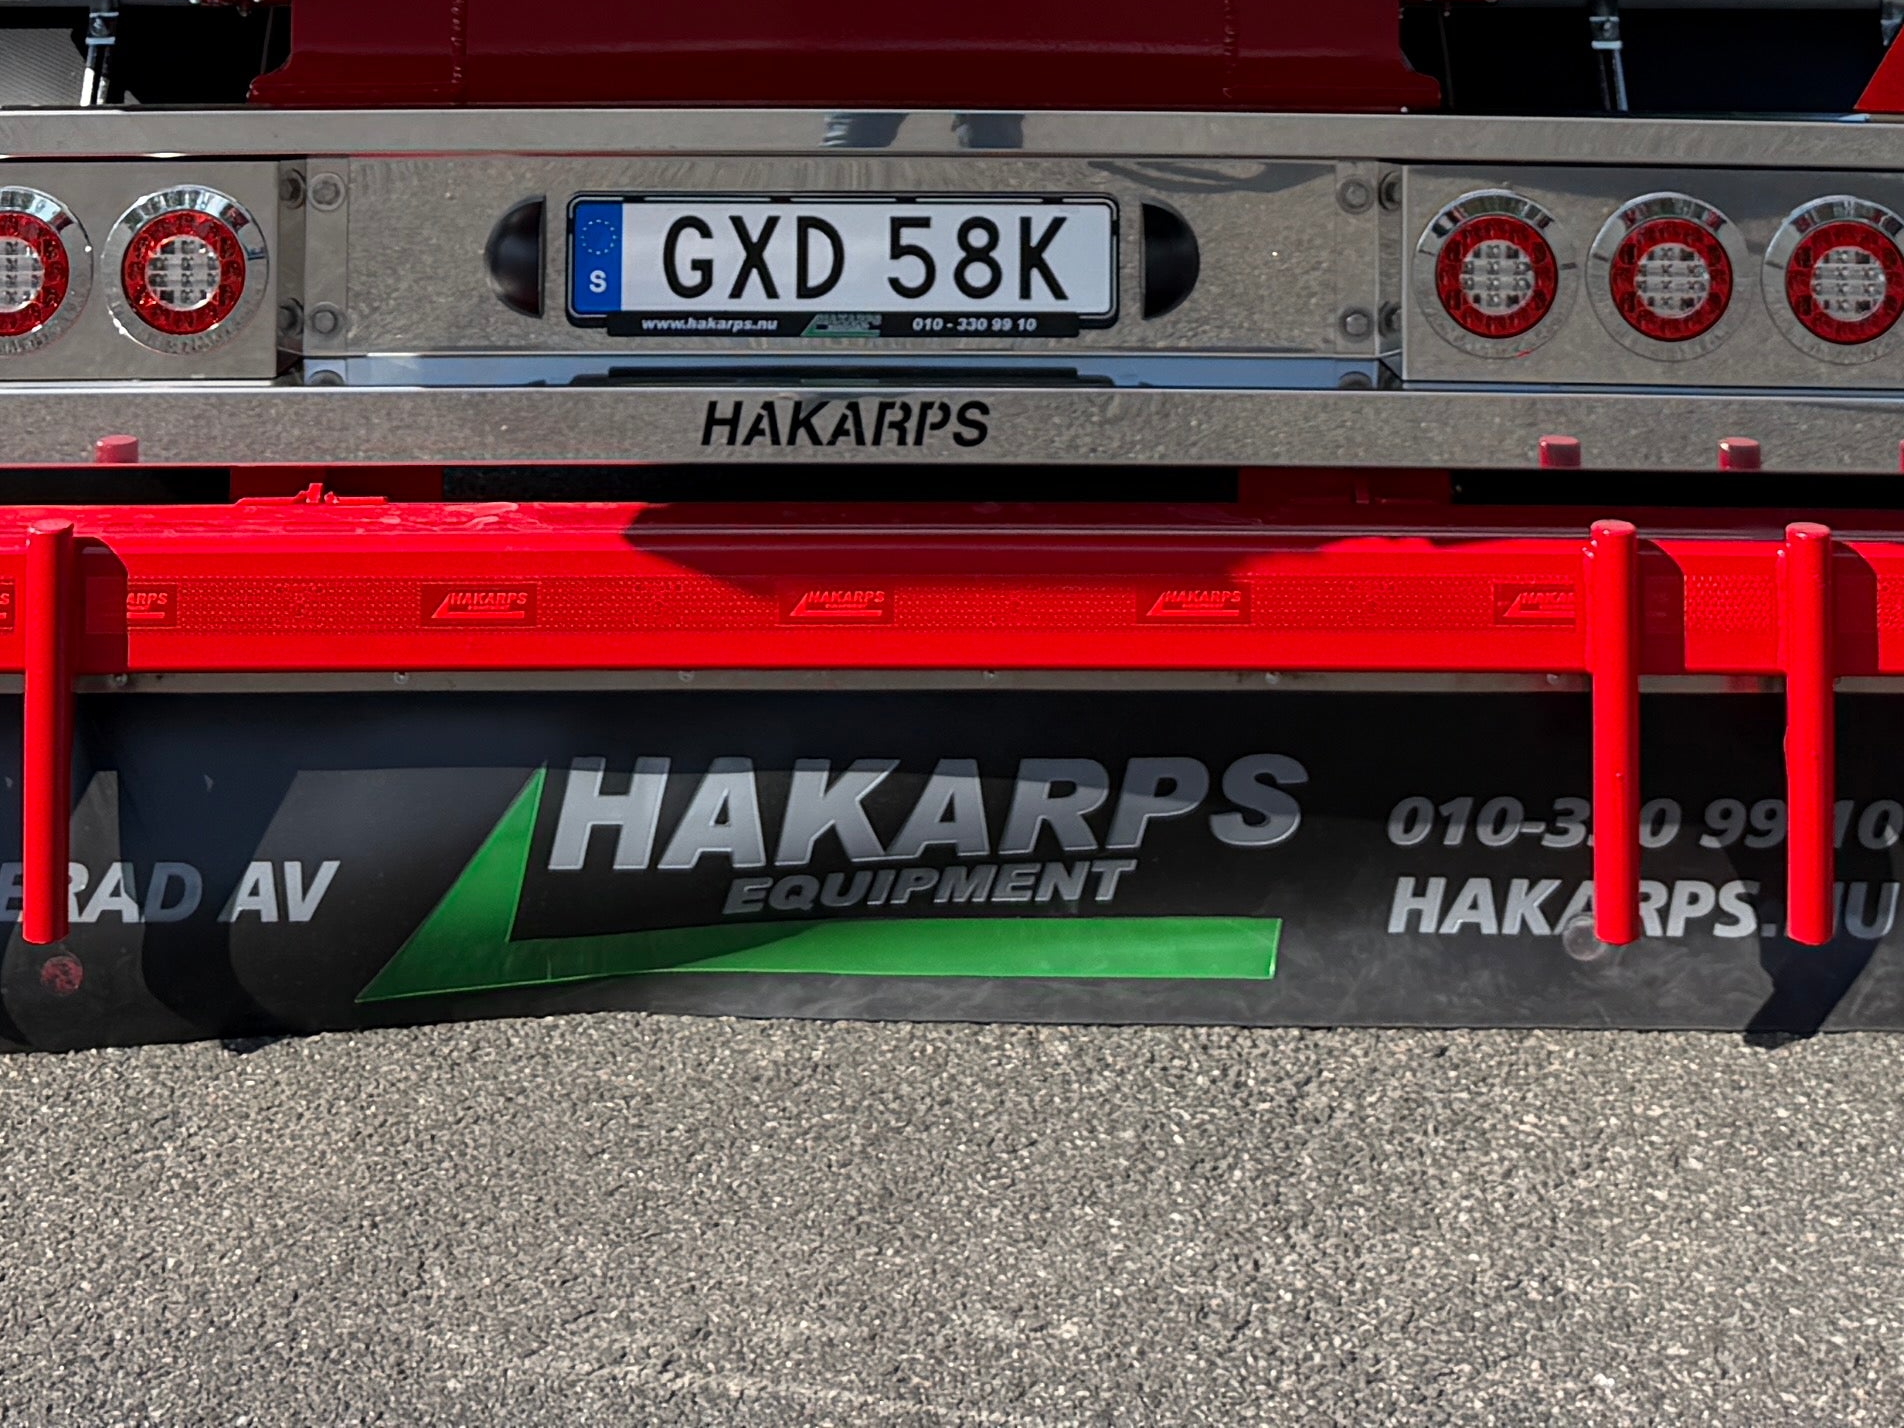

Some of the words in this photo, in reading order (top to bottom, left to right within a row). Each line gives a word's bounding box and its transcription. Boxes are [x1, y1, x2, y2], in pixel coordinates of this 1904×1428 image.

[589, 269, 607, 293] S
[663, 215, 845, 300] GXD
[887, 215, 1069, 301] 58K
[642, 316, 778, 333] www.hakarps.nu
[912, 317, 944, 331] 010
[957, 317, 988, 331] 330
[991, 317, 1013, 331] 99
[1017, 317, 1037, 331] 10
[700, 400, 991, 447] HAKARPS
[450, 592, 528, 604] HAKARPS
[808, 590, 885, 603] HAKARPS
[1164, 590, 1242, 602] HAKARPS
[548, 753, 1309, 870] HAKARPS
[1388, 796, 1682, 849] 010-30
[1699, 798, 1788, 849] 99
[216, 860, 341, 923] AV
[722, 858, 1137, 915] EQUIPMENT
[1388, 877, 1900, 940] HAKARPS.U
